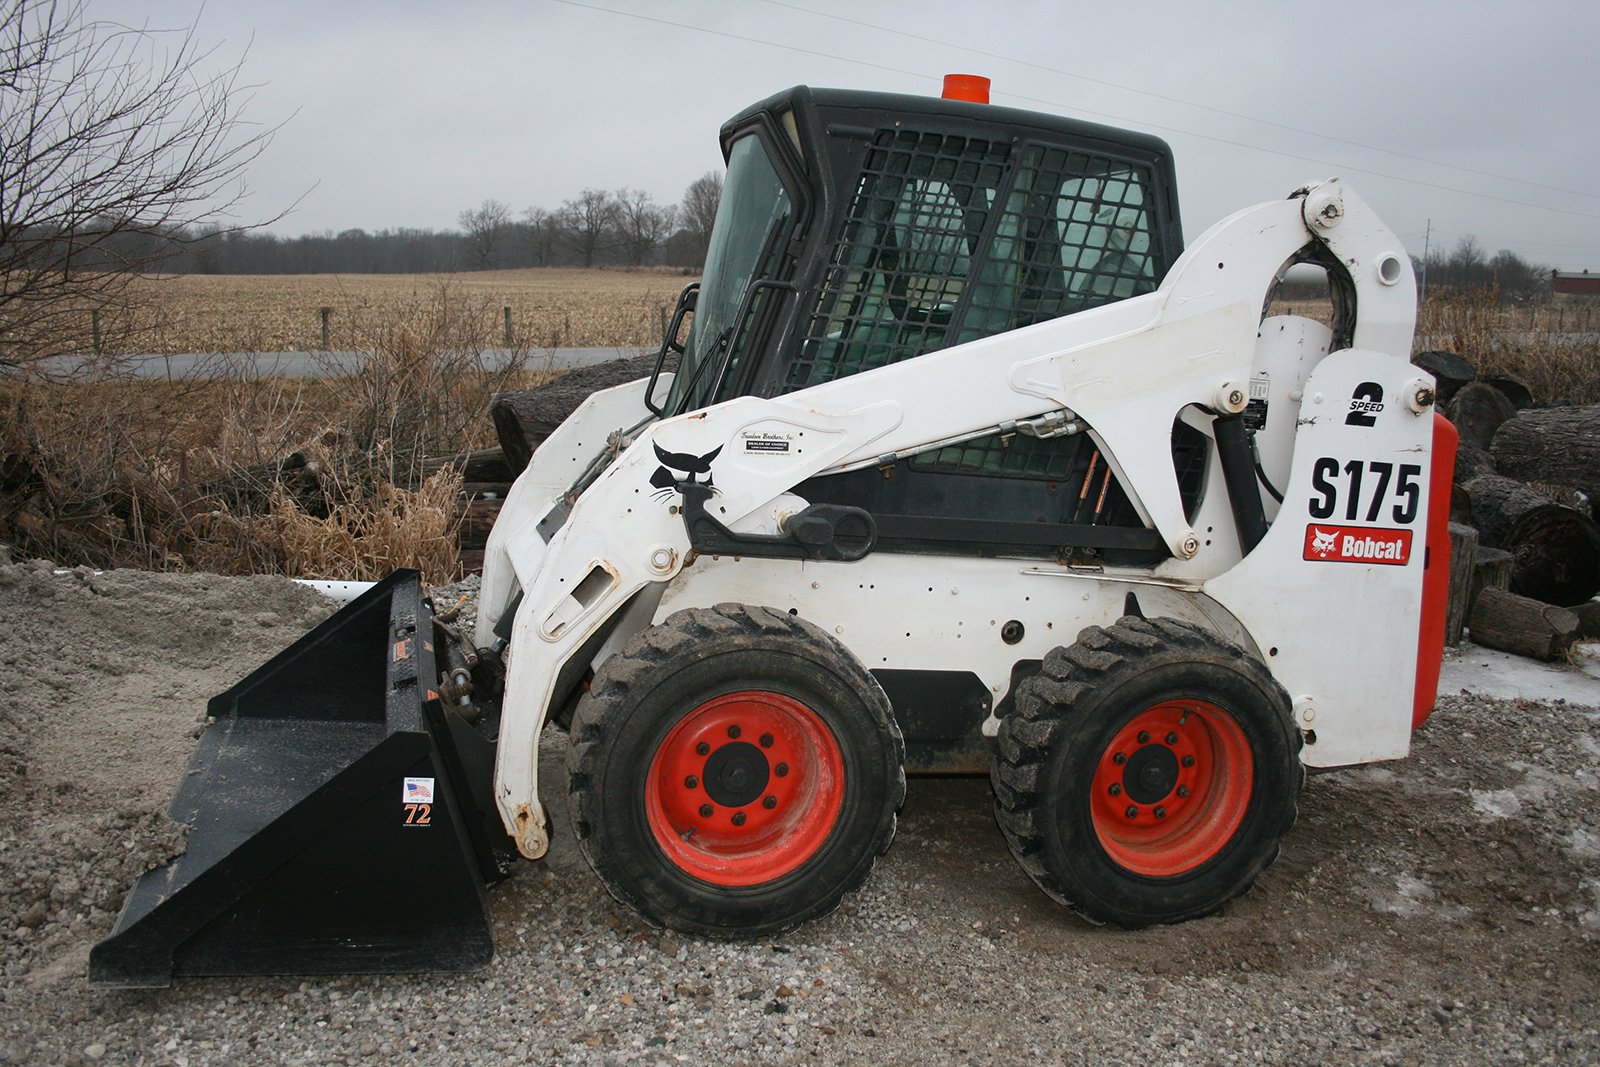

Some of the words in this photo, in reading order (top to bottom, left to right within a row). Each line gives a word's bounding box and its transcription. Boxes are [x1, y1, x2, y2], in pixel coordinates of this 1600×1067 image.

[1345, 382, 1383, 427] 2
[1350, 401, 1384, 413] SPEED
[1309, 457, 1421, 524] S175
[1341, 535, 1403, 560] Bobcat
[404, 803, 431, 824] 72
